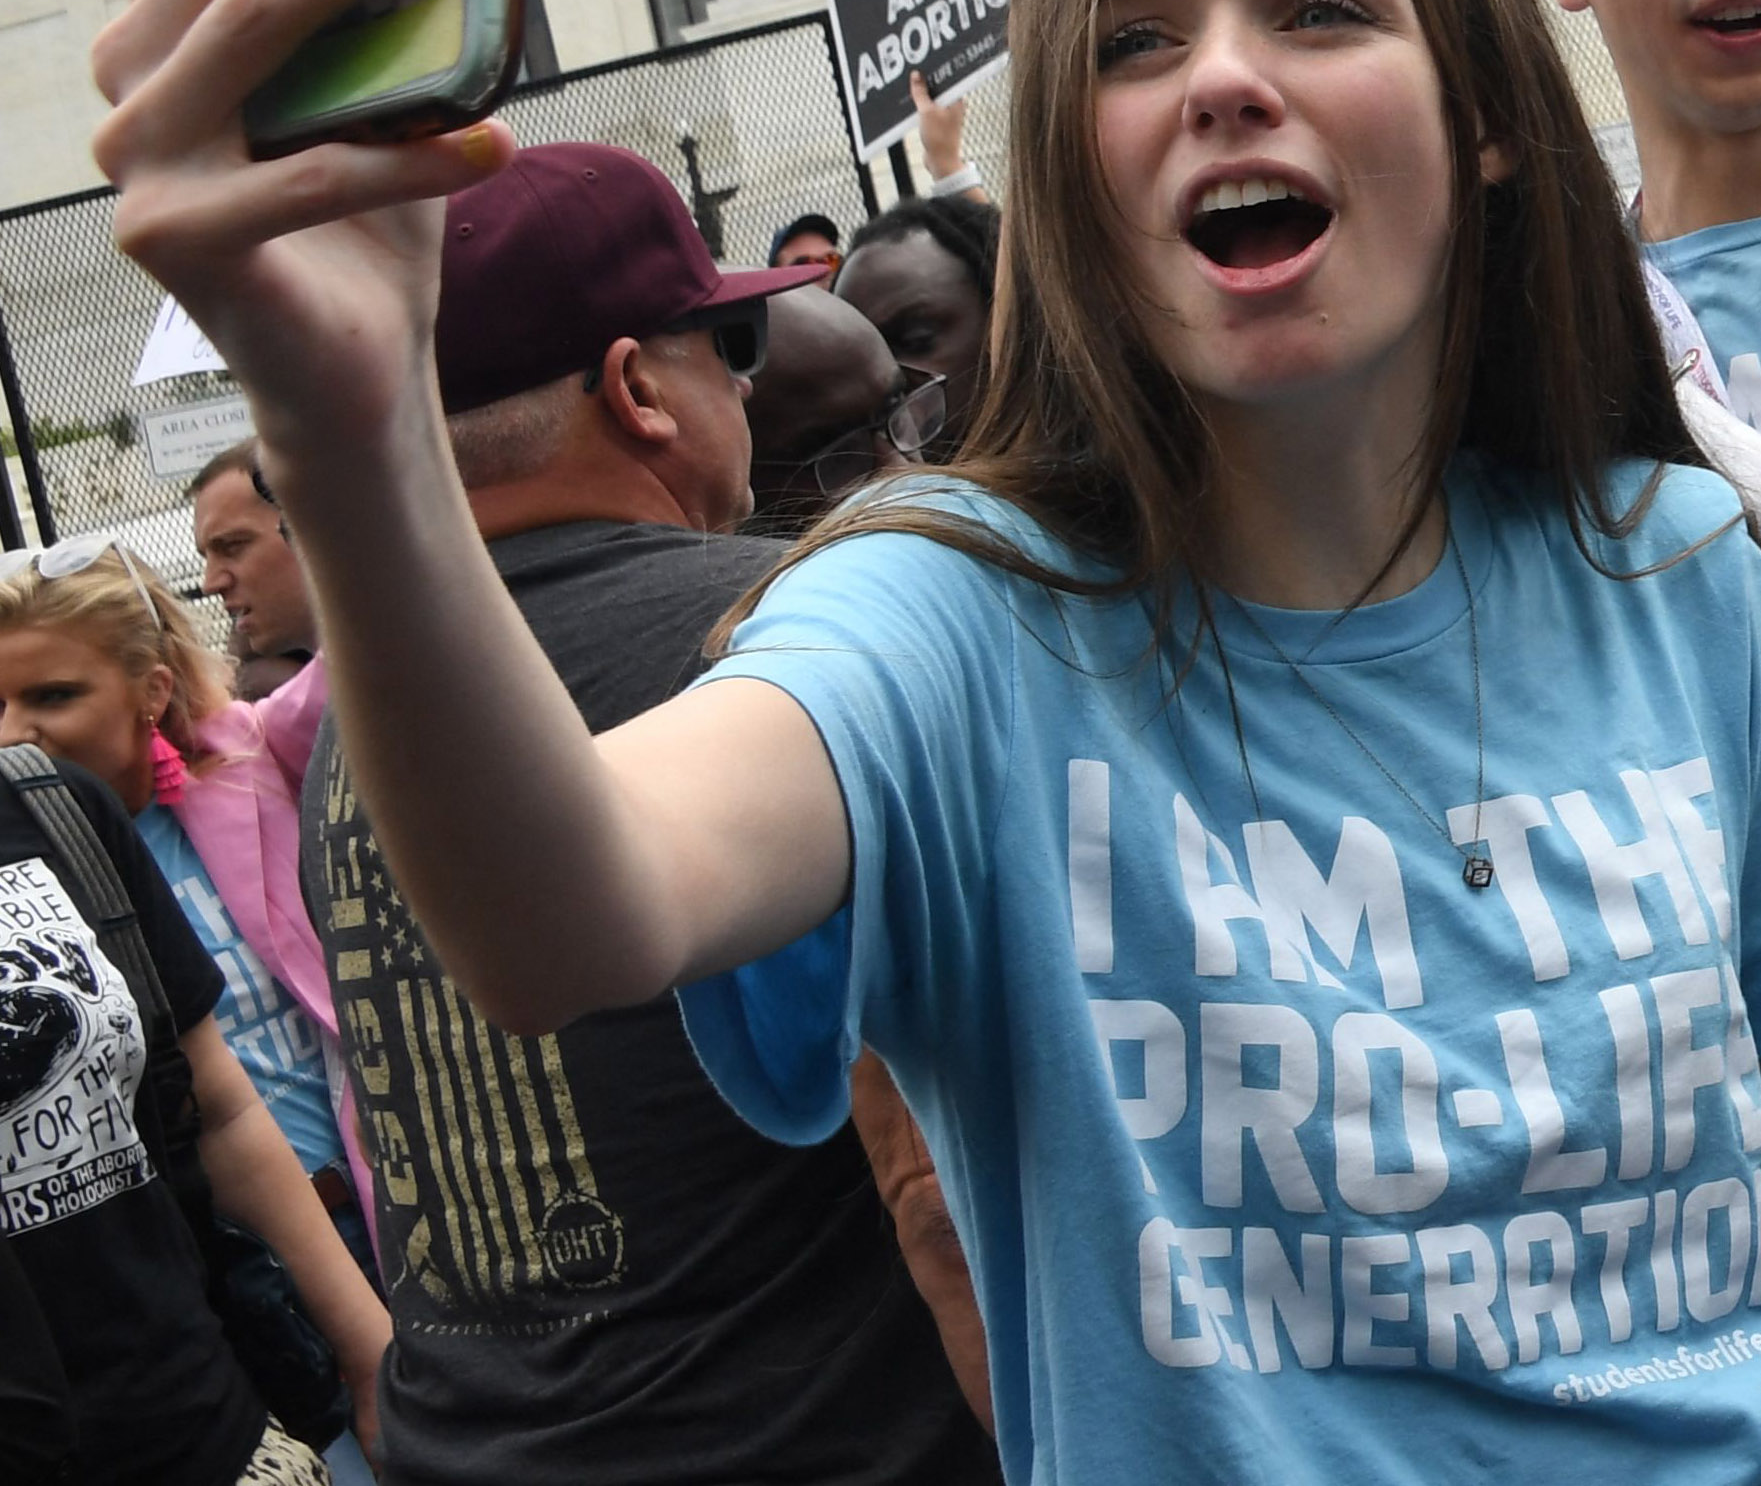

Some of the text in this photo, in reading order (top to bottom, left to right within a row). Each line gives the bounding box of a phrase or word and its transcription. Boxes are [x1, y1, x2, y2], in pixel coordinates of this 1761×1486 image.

[1068, 758, 1114, 974] I
[1173, 790, 1424, 1010] AM
[12, 1095, 82, 1158] FOR
[47, 1173, 71, 1197] OF
[71, 1162, 97, 1187] THE
[53, 1169, 134, 1217] HOLOCAUST
